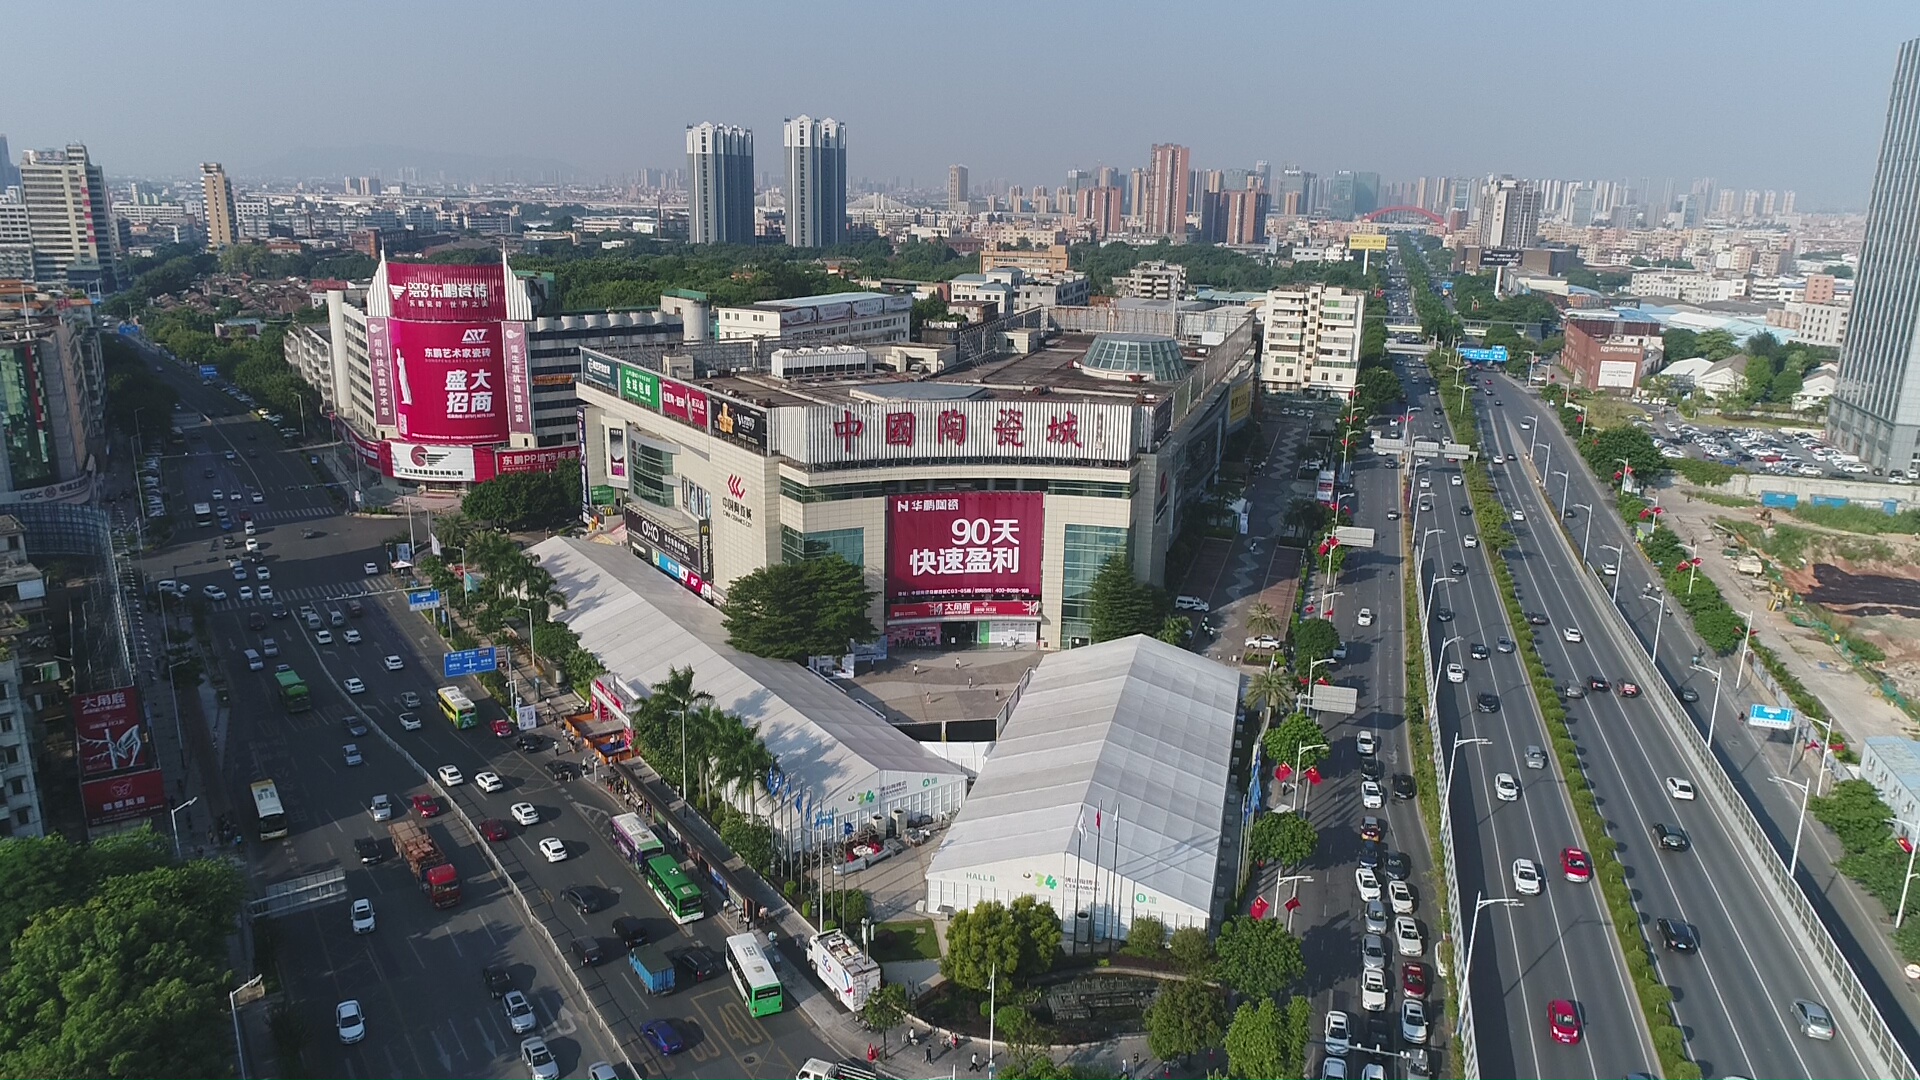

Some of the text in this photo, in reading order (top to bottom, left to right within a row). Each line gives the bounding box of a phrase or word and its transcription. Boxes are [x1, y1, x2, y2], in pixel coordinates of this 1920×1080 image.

[445, 368, 492, 391] 盛大
[446, 391, 493, 414] 招商
[951, 518, 1020, 546] 90天
[909, 546, 1020, 576] 快速盈利
[966, 872, 988, 882] HALL
